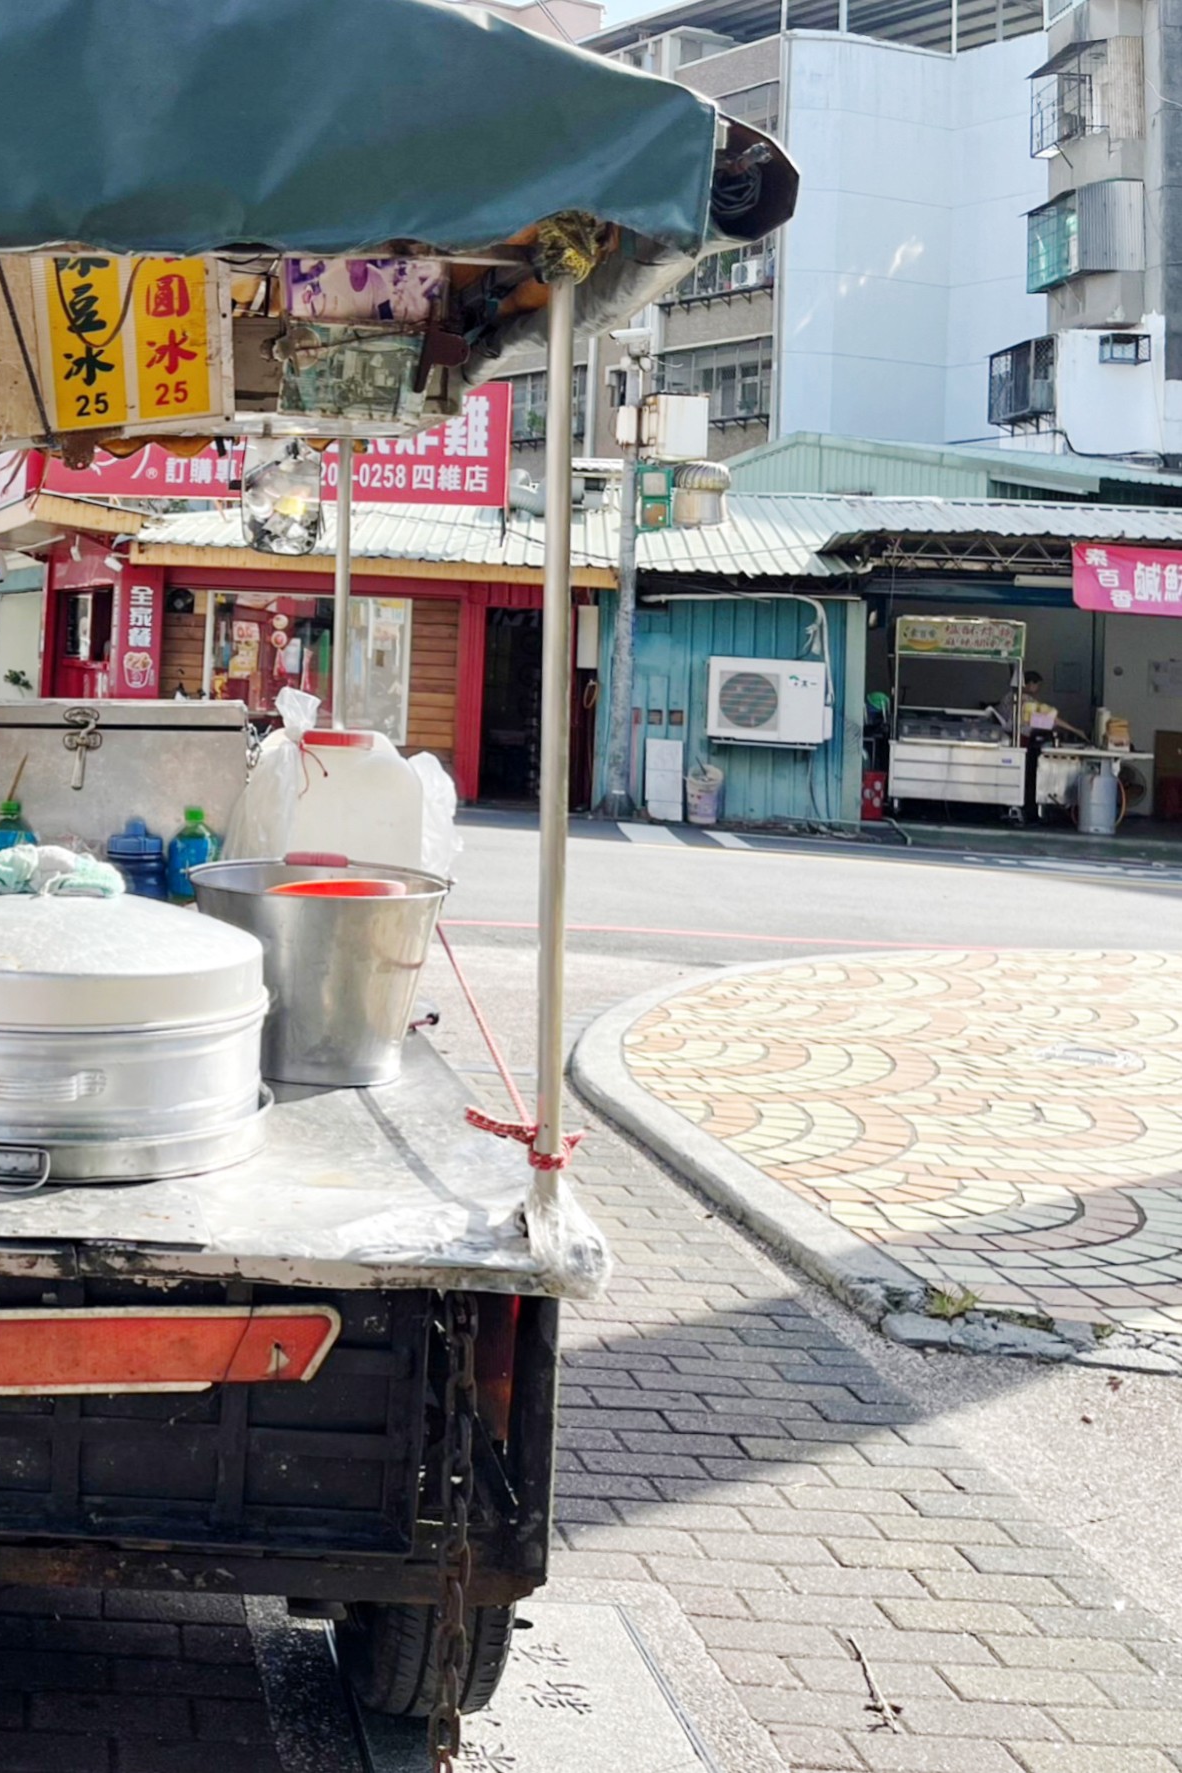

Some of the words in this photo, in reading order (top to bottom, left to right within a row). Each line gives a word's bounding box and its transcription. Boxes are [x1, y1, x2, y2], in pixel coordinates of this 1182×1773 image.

[145, 258, 198, 375] 圓冰
[76, 392, 109, 417] 25
[155, 381, 189, 406] 25
[412, 465, 489, 492] 四維店
